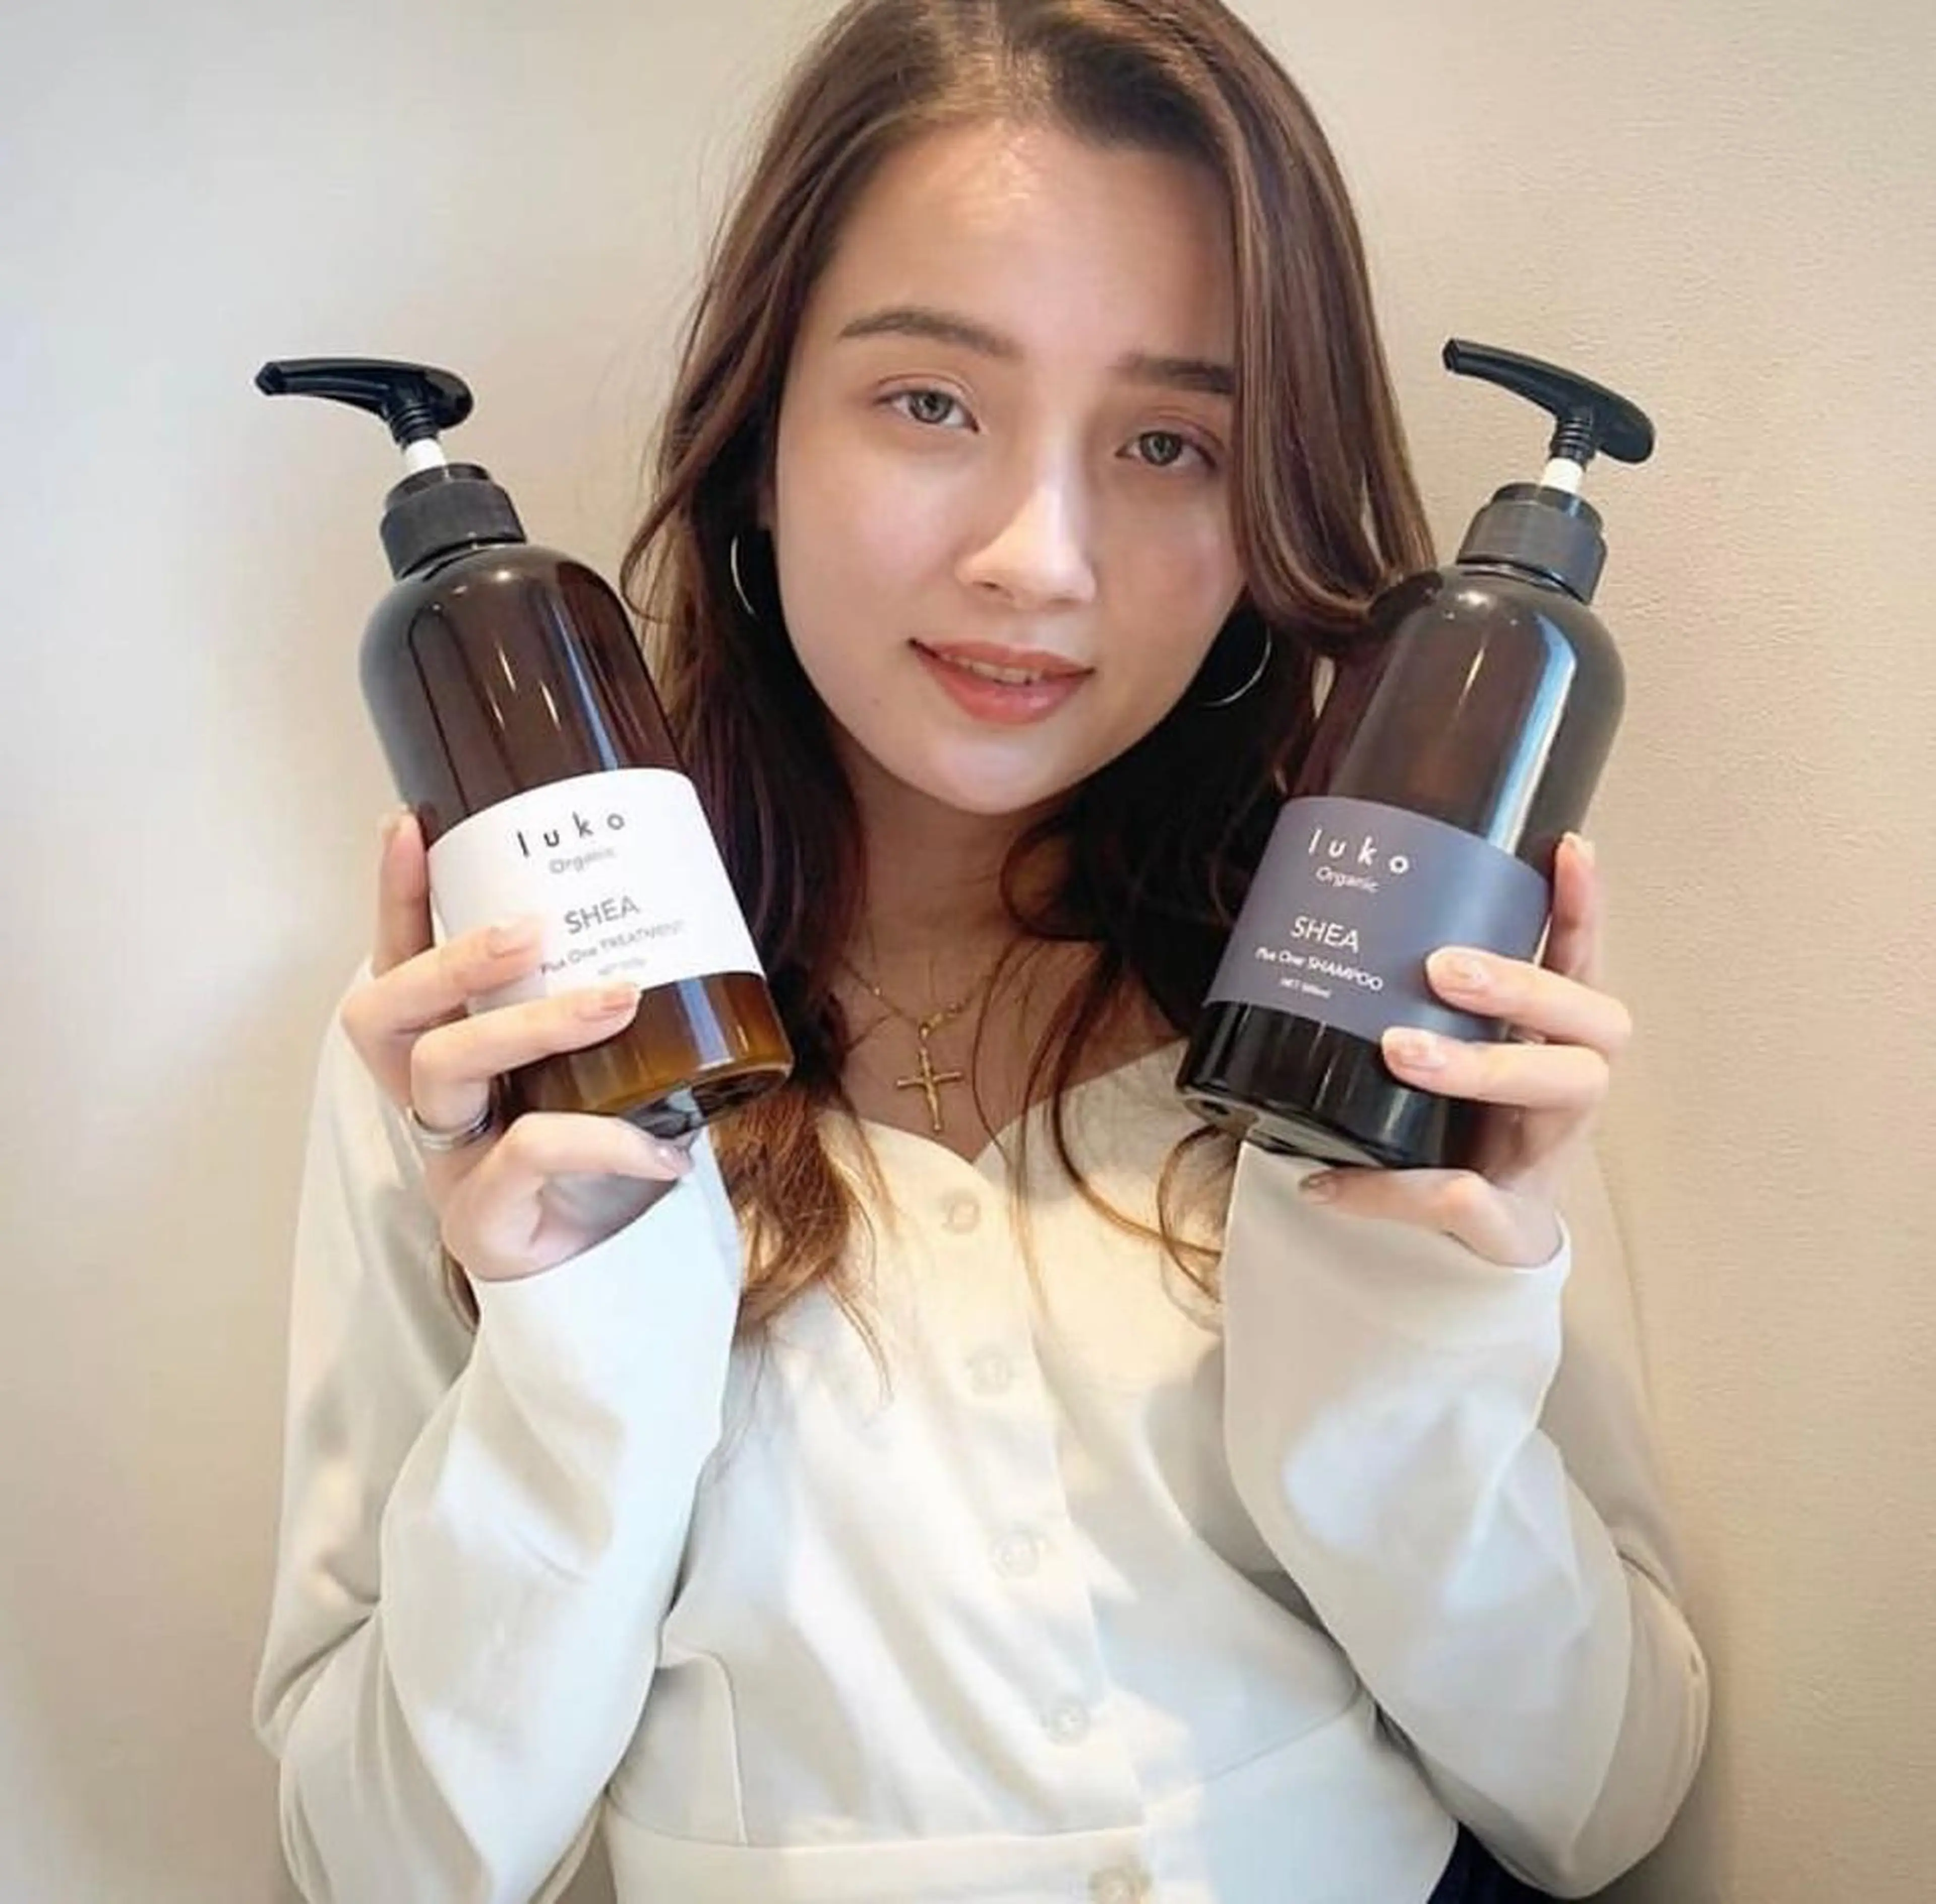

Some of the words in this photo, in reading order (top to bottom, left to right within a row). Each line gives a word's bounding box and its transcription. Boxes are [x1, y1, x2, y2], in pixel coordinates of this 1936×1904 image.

[517, 811, 625, 858] luko
[1308, 828, 1409, 874] luko
[1316, 866, 1380, 894] Organic
[564, 895, 641, 935] SHEA
[1290, 915, 1359, 954] SHEA
[1307, 956, 1383, 991] SHAMPOO
